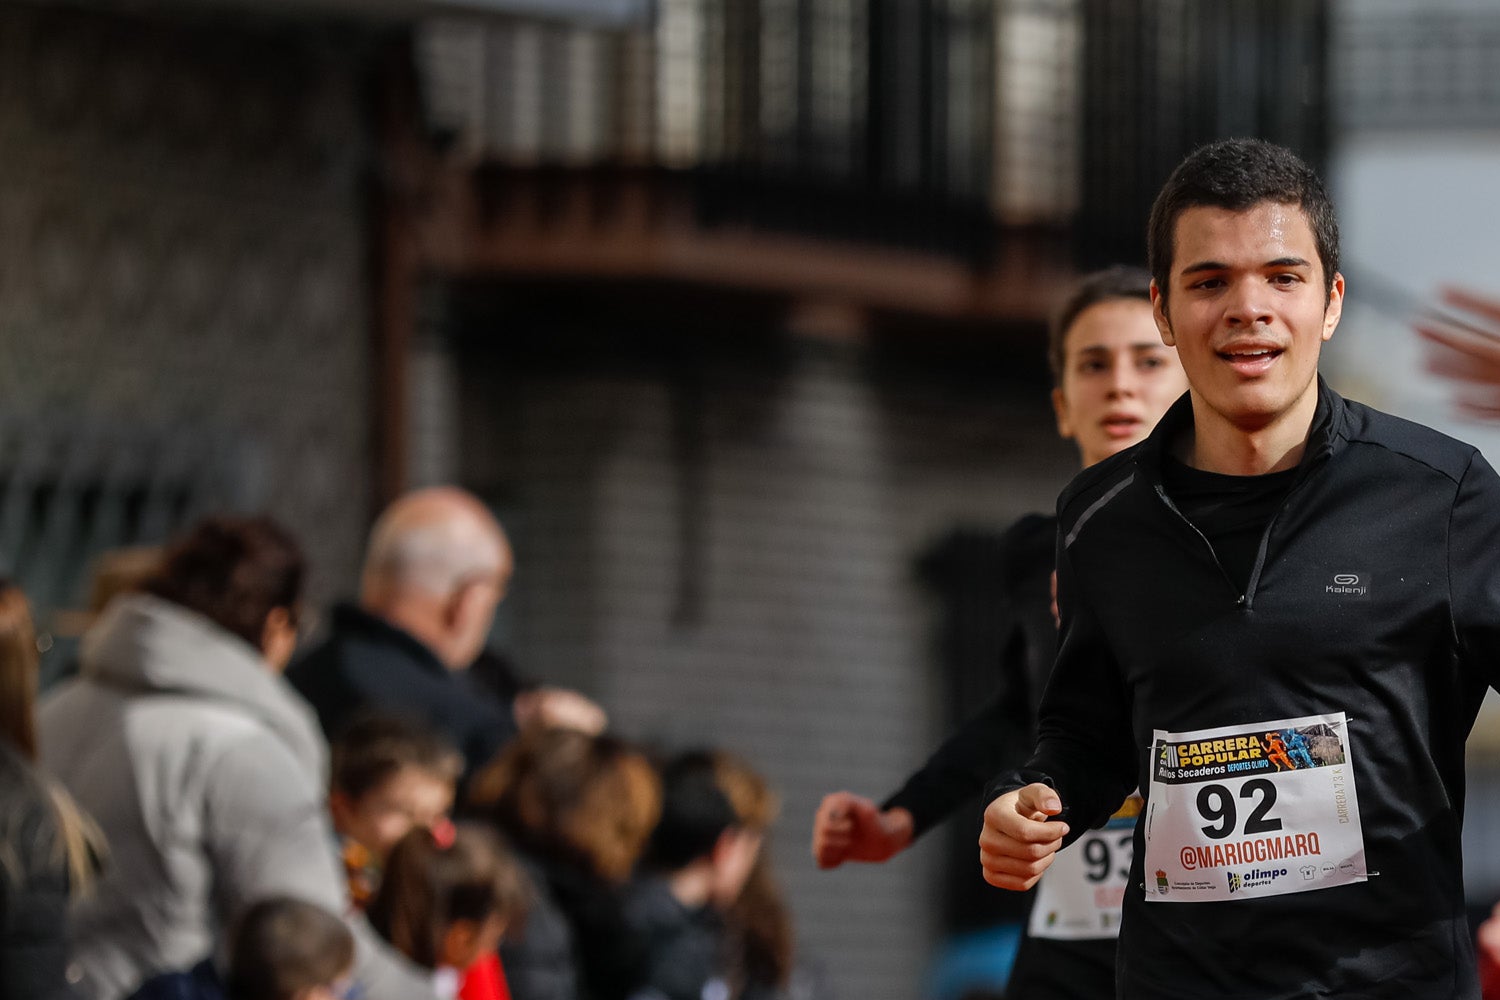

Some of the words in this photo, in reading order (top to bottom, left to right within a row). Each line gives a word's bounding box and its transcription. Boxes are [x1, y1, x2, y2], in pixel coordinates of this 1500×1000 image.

[1325, 585, 1367, 596] Kalenji
[1177, 736, 1261, 757] CARRERA
[1180, 748, 1262, 767] POPULAR
[1177, 765, 1226, 779] Secaderos
[1227, 761, 1252, 773] DEPORTES
[1252, 759, 1269, 769] OLIMPO
[1196, 778, 1283, 839] 92
[1335, 788, 1350, 824] CARRERA
[1180, 832, 1321, 871] @MARIOGMARQ
[1243, 868, 1288, 881] olimpo
[1243, 880, 1271, 888] deportes
